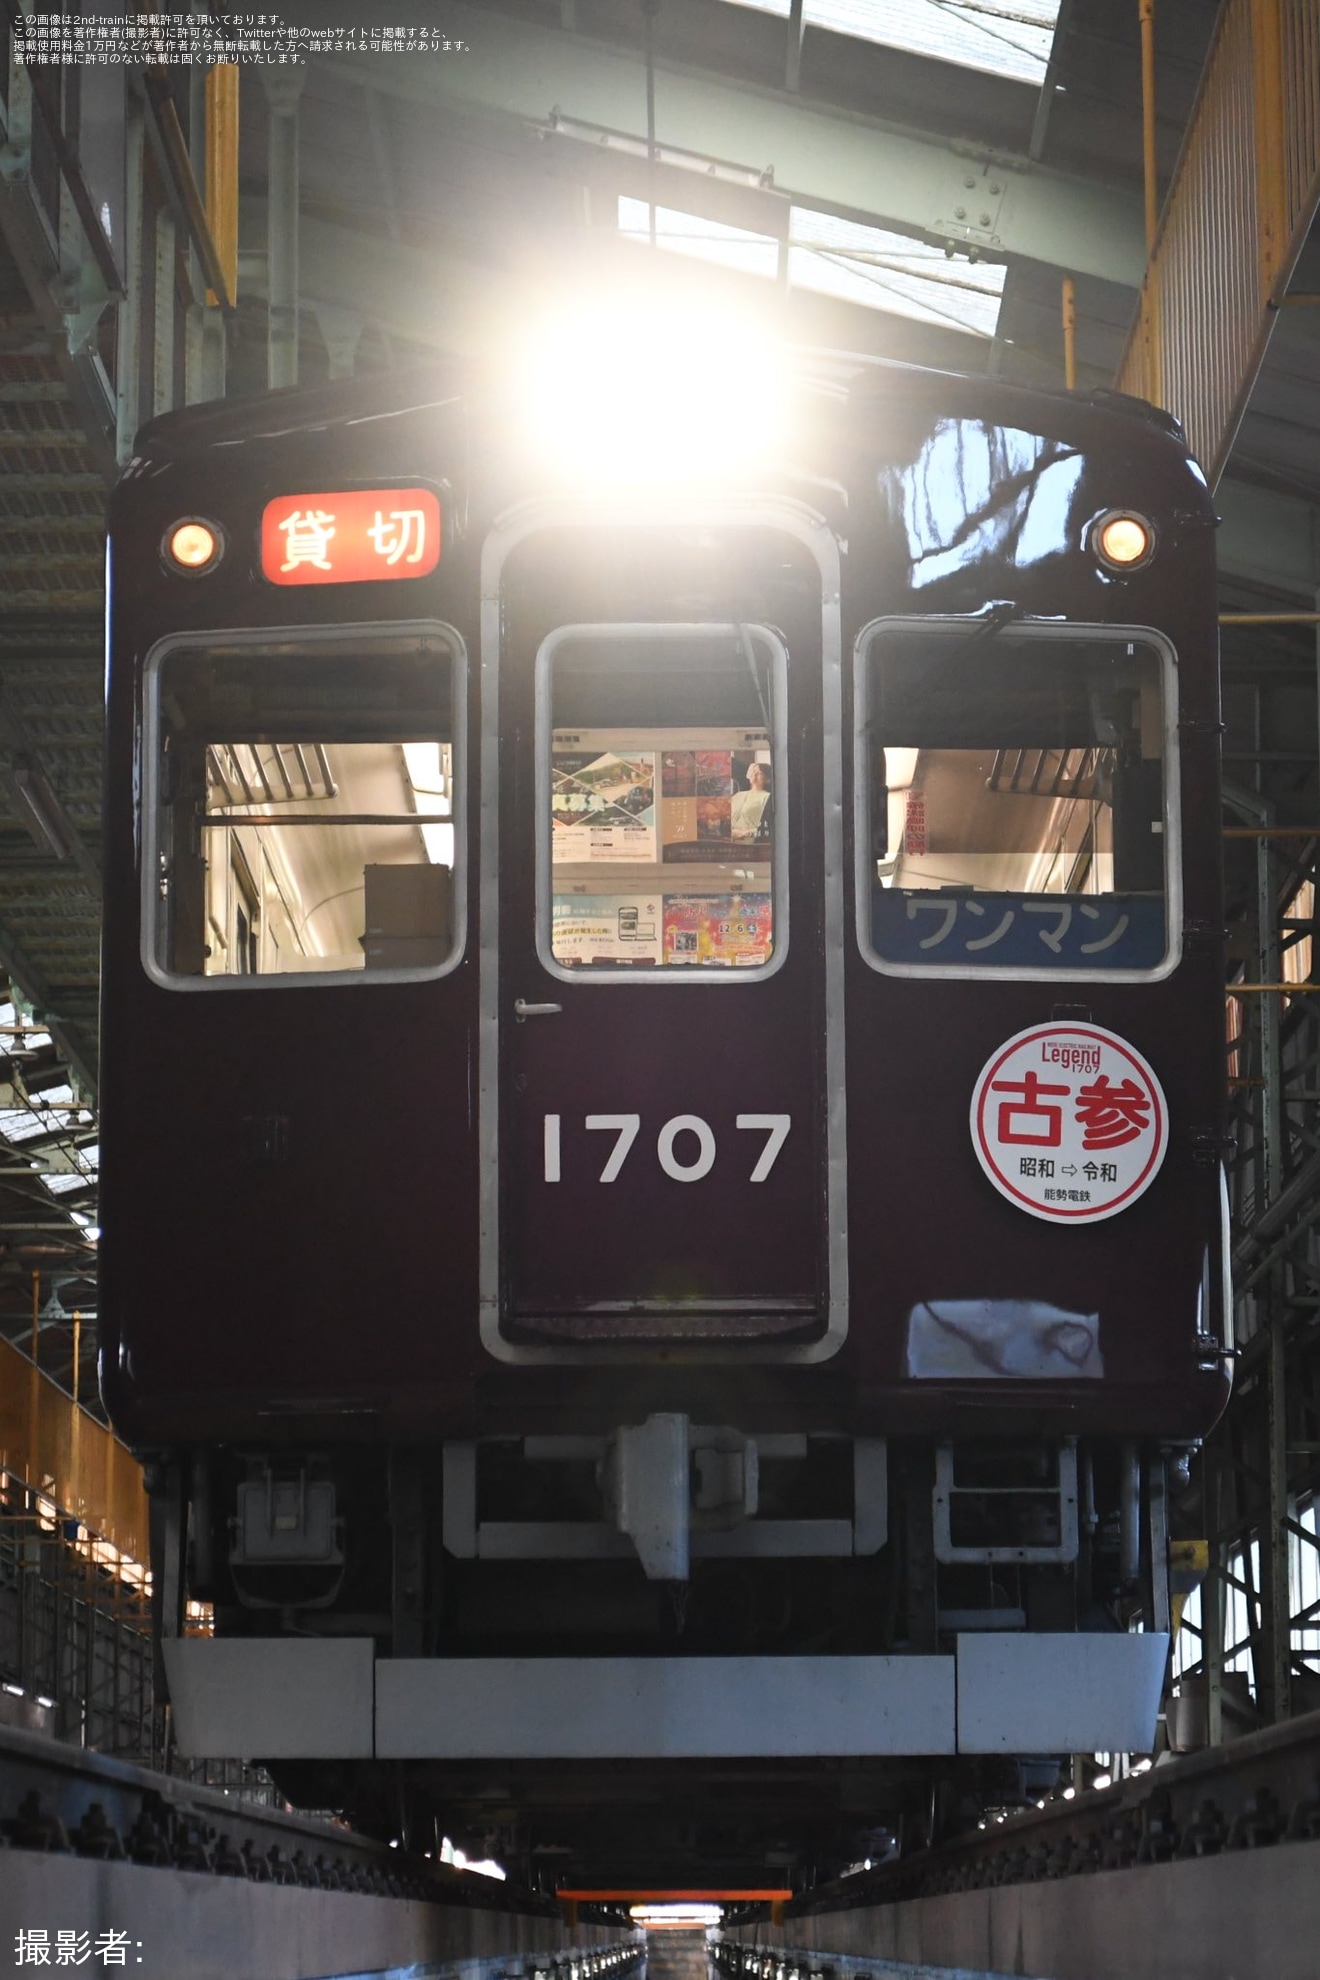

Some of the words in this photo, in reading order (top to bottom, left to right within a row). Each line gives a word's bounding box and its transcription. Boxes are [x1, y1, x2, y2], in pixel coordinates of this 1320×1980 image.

[278, 510, 426, 572] 貸切
[906, 899, 1130, 954] ワンマン
[1042, 1042, 1100, 1069] Legend
[1072, 1064, 1100, 1074] 1707
[991, 1071, 1151, 1151] 古参
[544, 1113, 791, 1183] 1707
[1020, 1157, 1055, 1178] 昭和
[1082, 1161, 1117, 1182] 令和
[1044, 1188, 1091, 1202] 能勢電鉄
